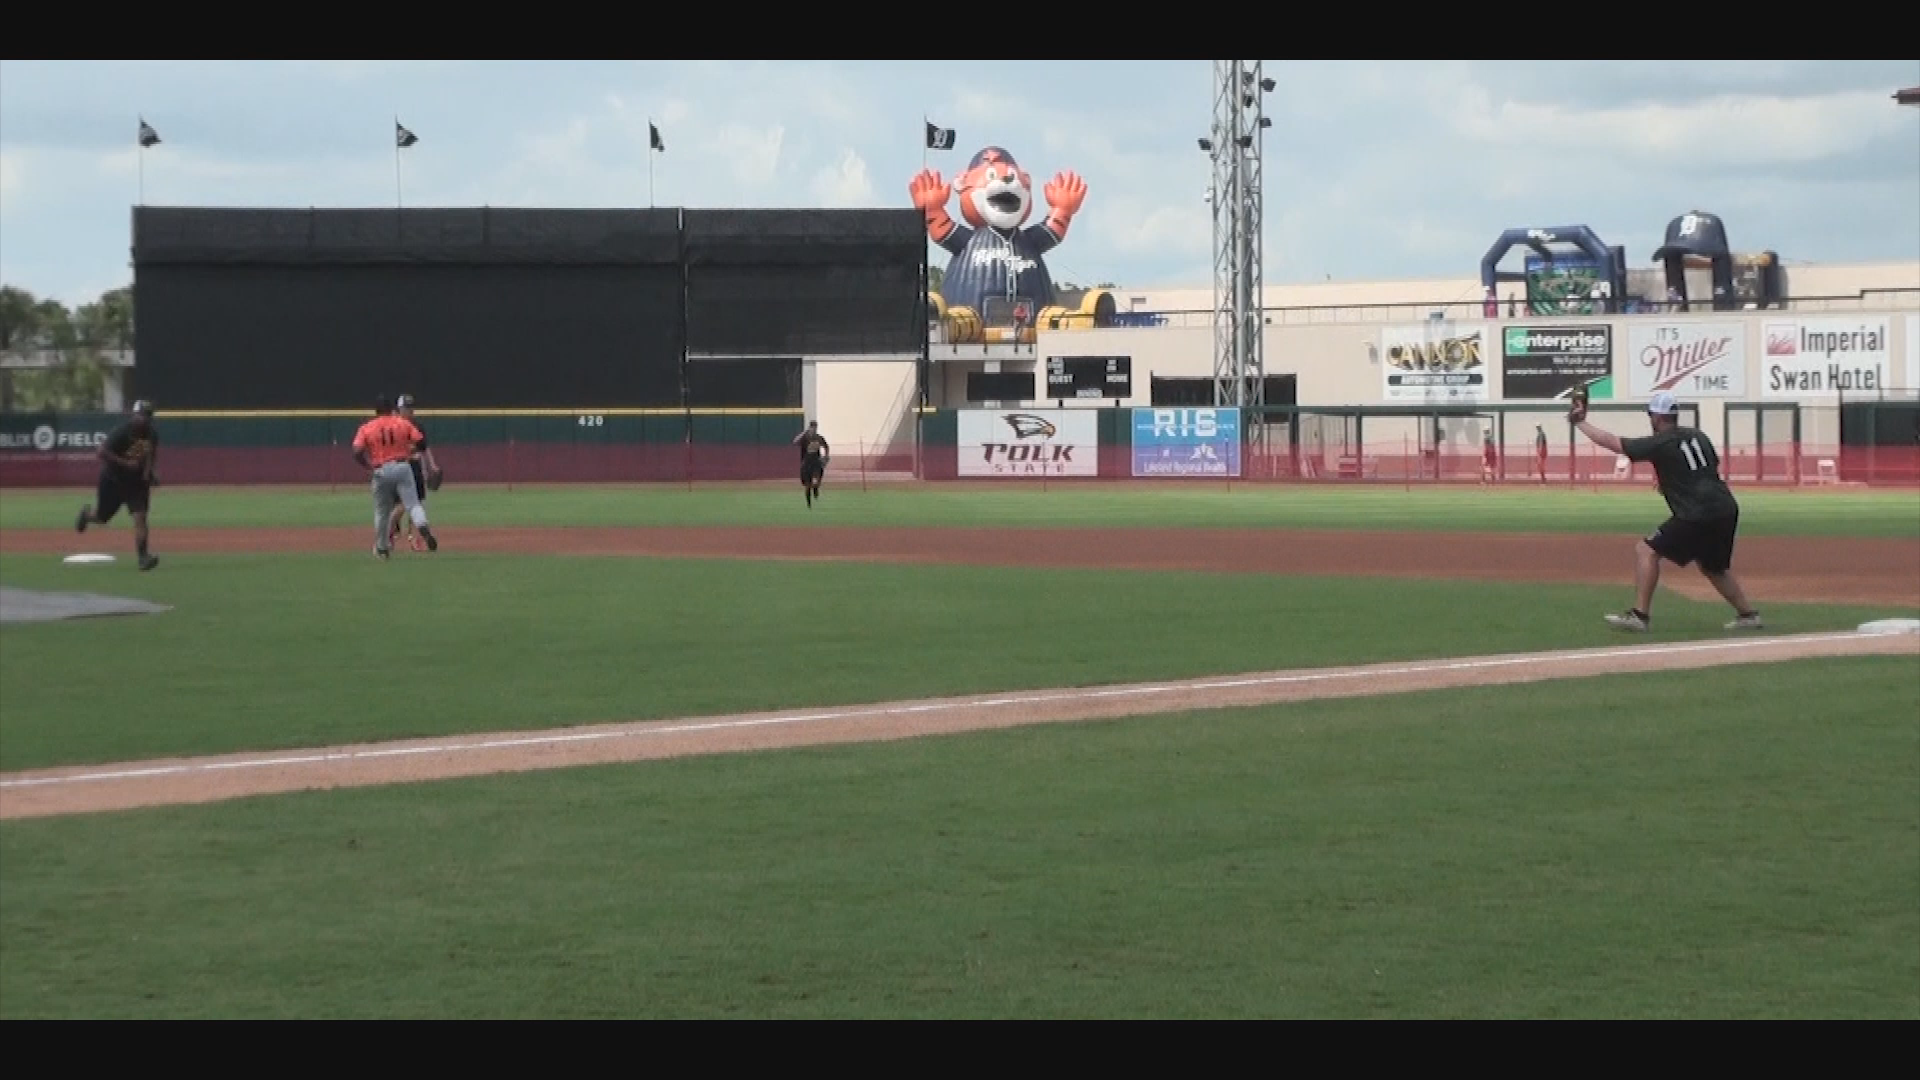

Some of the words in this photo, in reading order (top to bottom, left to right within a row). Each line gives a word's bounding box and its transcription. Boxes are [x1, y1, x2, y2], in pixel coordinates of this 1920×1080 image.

[1508, 332, 1605, 351] enterprise
[1656, 327, 1679, 340] IT'S
[1801, 325, 1884, 358] Imperial
[1640, 336, 1733, 384] Miller
[1694, 375, 1728, 390] TIME
[1770, 365, 1822, 390] Swan
[1829, 363, 1881, 390] Hotel
[578, 415, 603, 427] 420
[380, 427, 394, 447] 11
[981, 444, 1074, 463] POLK
[1681, 438, 1707, 470] 11
[994, 464, 1064, 473] STATE
